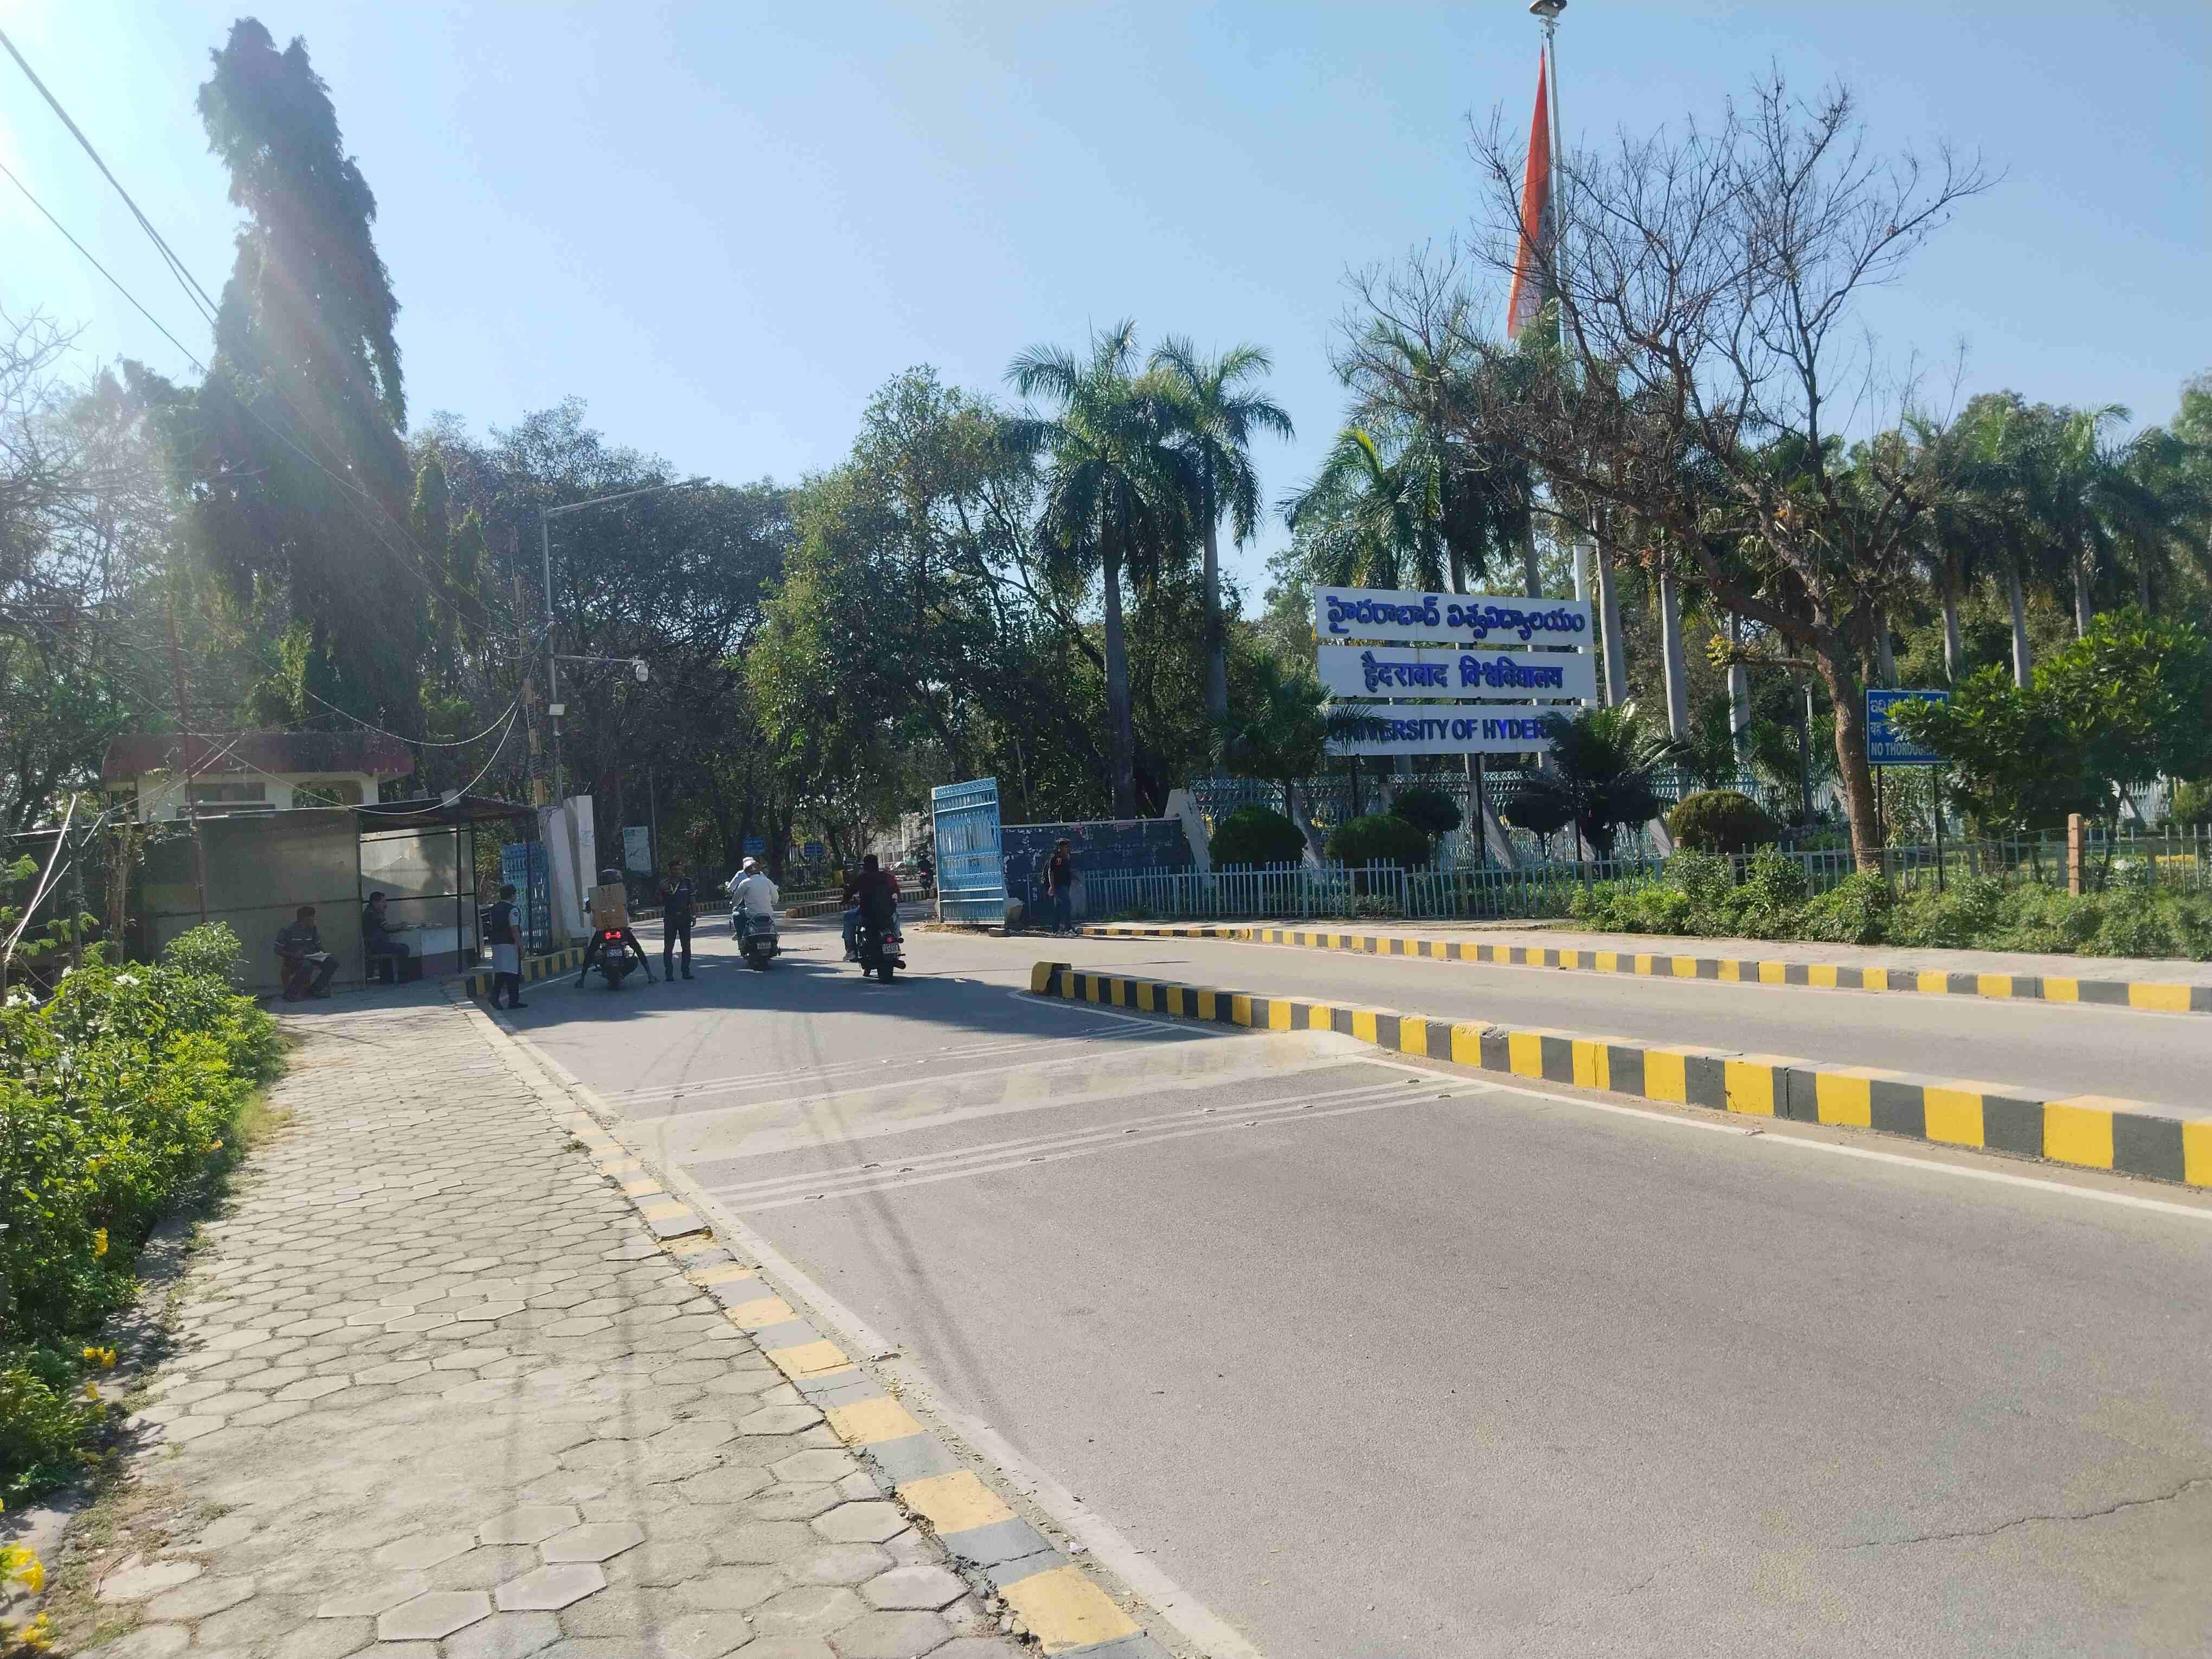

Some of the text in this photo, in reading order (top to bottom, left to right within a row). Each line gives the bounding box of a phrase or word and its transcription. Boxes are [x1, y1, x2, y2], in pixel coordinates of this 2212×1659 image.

[1326, 596, 1585, 641] హైదరాబాద్ విశ్వవిద్యాలయం
[1360, 651, 1564, 693] हैदराबाद विश्वविद्यालय
[1452, 719, 1478, 740] OF
[1482, 719, 1551, 740] HYDER
[1871, 742, 1883, 756] NO
